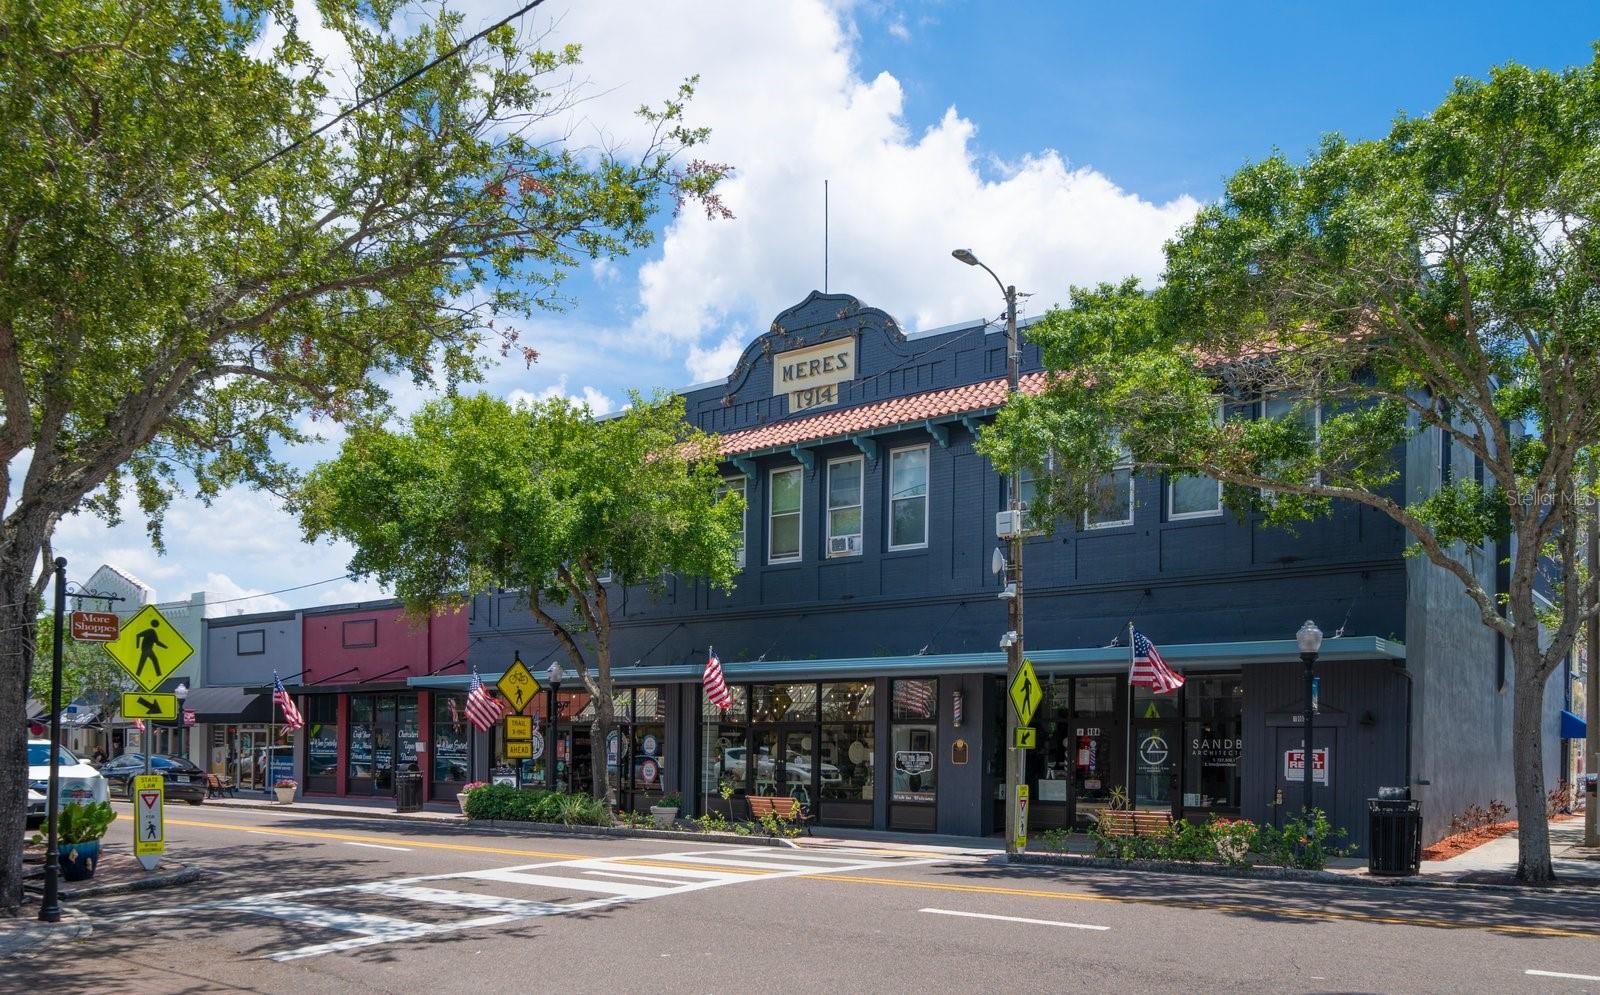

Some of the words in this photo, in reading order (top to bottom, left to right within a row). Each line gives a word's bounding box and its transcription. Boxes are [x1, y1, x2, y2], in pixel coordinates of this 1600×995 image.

[782, 352, 848, 382] MERES
[796, 385, 833, 408] 1914
[82, 613, 110, 624] More
[75, 622, 117, 633] Shoppes
